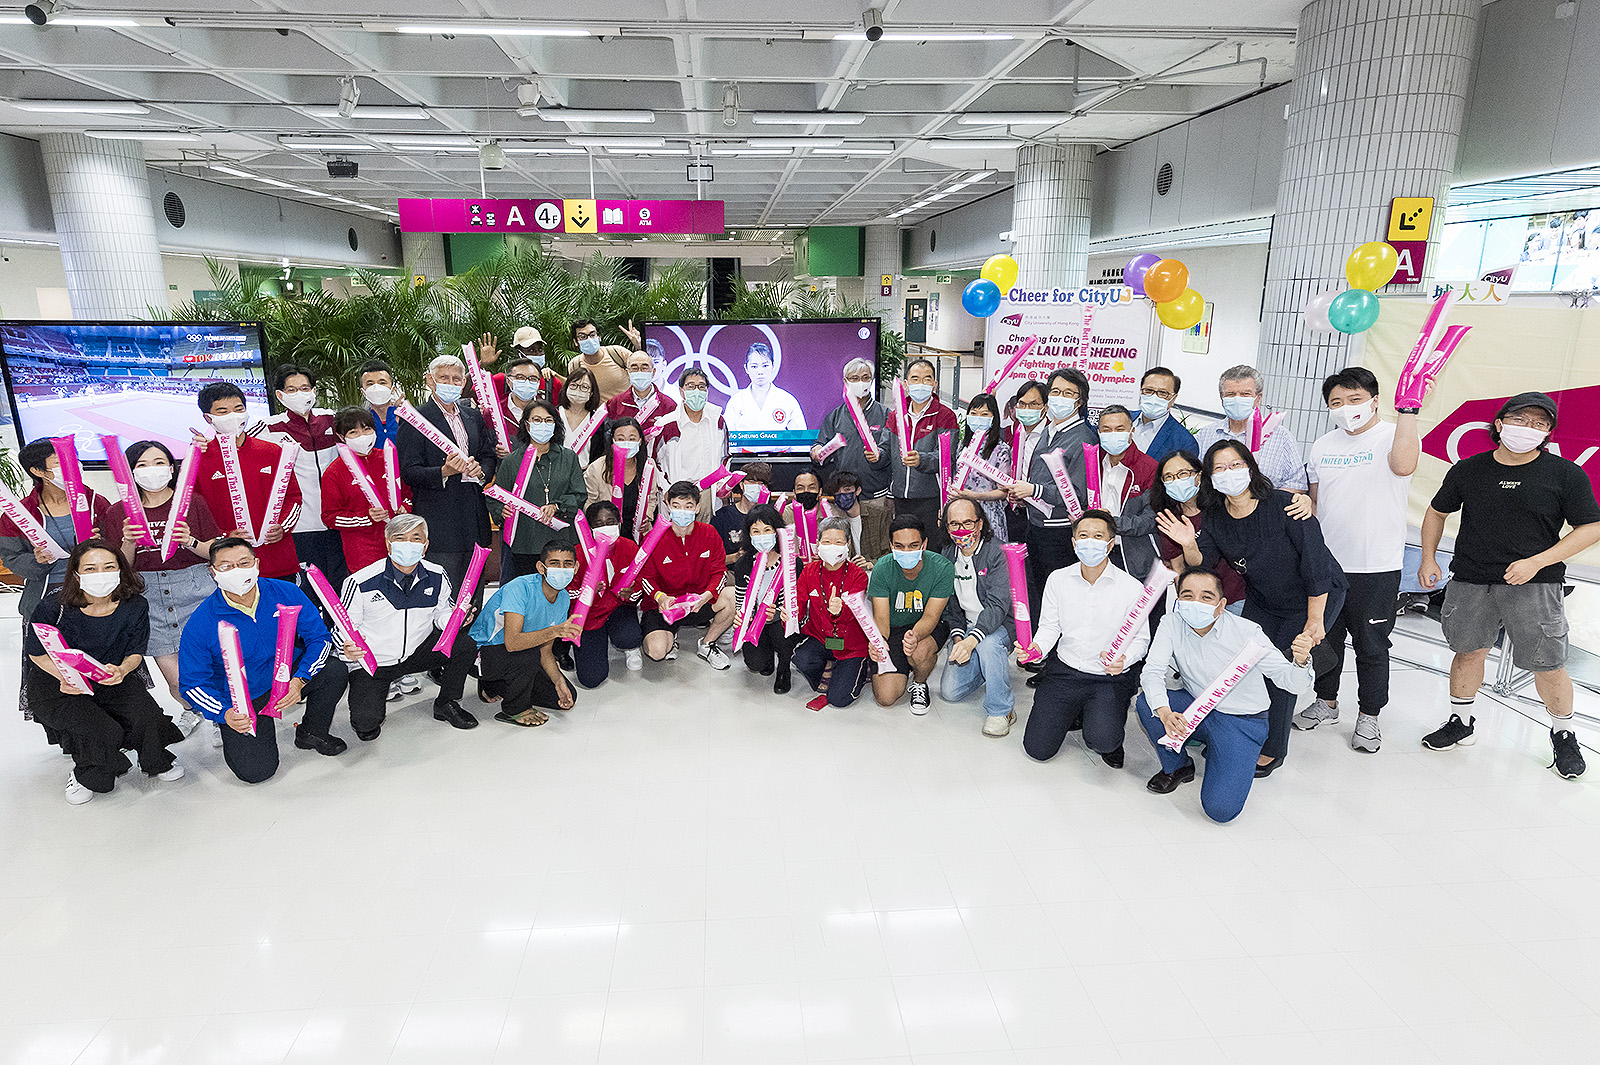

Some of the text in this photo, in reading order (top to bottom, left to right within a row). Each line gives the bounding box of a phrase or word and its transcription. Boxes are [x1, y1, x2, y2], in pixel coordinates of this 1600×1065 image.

[506, 206, 526, 226] A
[538, 208, 558, 224] 4F
[1397, 248, 1415, 276] A
[1484, 274, 1508, 284] CityU
[1009, 288, 1121, 306] Cheer for CityU
[1084, 314, 1092, 326] The
[1064, 335, 1080, 345] City
[1092, 336, 1125, 344] Alumna
[1082, 328, 1091, 340] Best
[1037, 346, 1060, 356] LAU
[1081, 343, 1089, 356] That
[1019, 360, 1055, 370] Fighting
[1079, 358, 1087, 368] We
[1028, 371, 1037, 380] @
[1092, 374, 1136, 384] Olympics
[400, 406, 453, 454] Be The Best That We
[284, 462, 294, 470] Be
[963, 452, 1011, 484] Be The Best That
[281, 471, 291, 484] Can
[1055, 470, 1064, 478] Be
[220, 436, 246, 530] Be The Best That We Can Be
[278, 484, 286, 495] We
[1060, 477, 1068, 490] Can
[1064, 489, 1073, 499] We
[274, 496, 284, 511] That
[1068, 499, 1081, 513] That
[2, 502, 20, 518] That
[17, 517, 29, 529] We
[26, 528, 39, 542] Can
[36, 540, 48, 549] Be
[790, 584, 797, 594] We
[791, 610, 798, 618] Be
[853, 606, 862, 616] The
[860, 616, 869, 628] Best
[865, 627, 876, 639] That
[1106, 649, 1116, 662] The
[1111, 634, 1124, 650] Best
[1120, 619, 1134, 636] That
[1129, 609, 1141, 620] We
[1136, 596, 1149, 609] Can
[1145, 586, 1155, 597] Be
[1187, 714, 1202, 730] Best
[1197, 698, 1217, 716] That
[1212, 688, 1229, 698] We
[1223, 674, 1242, 687] Can
[1235, 663, 1250, 674] Be
